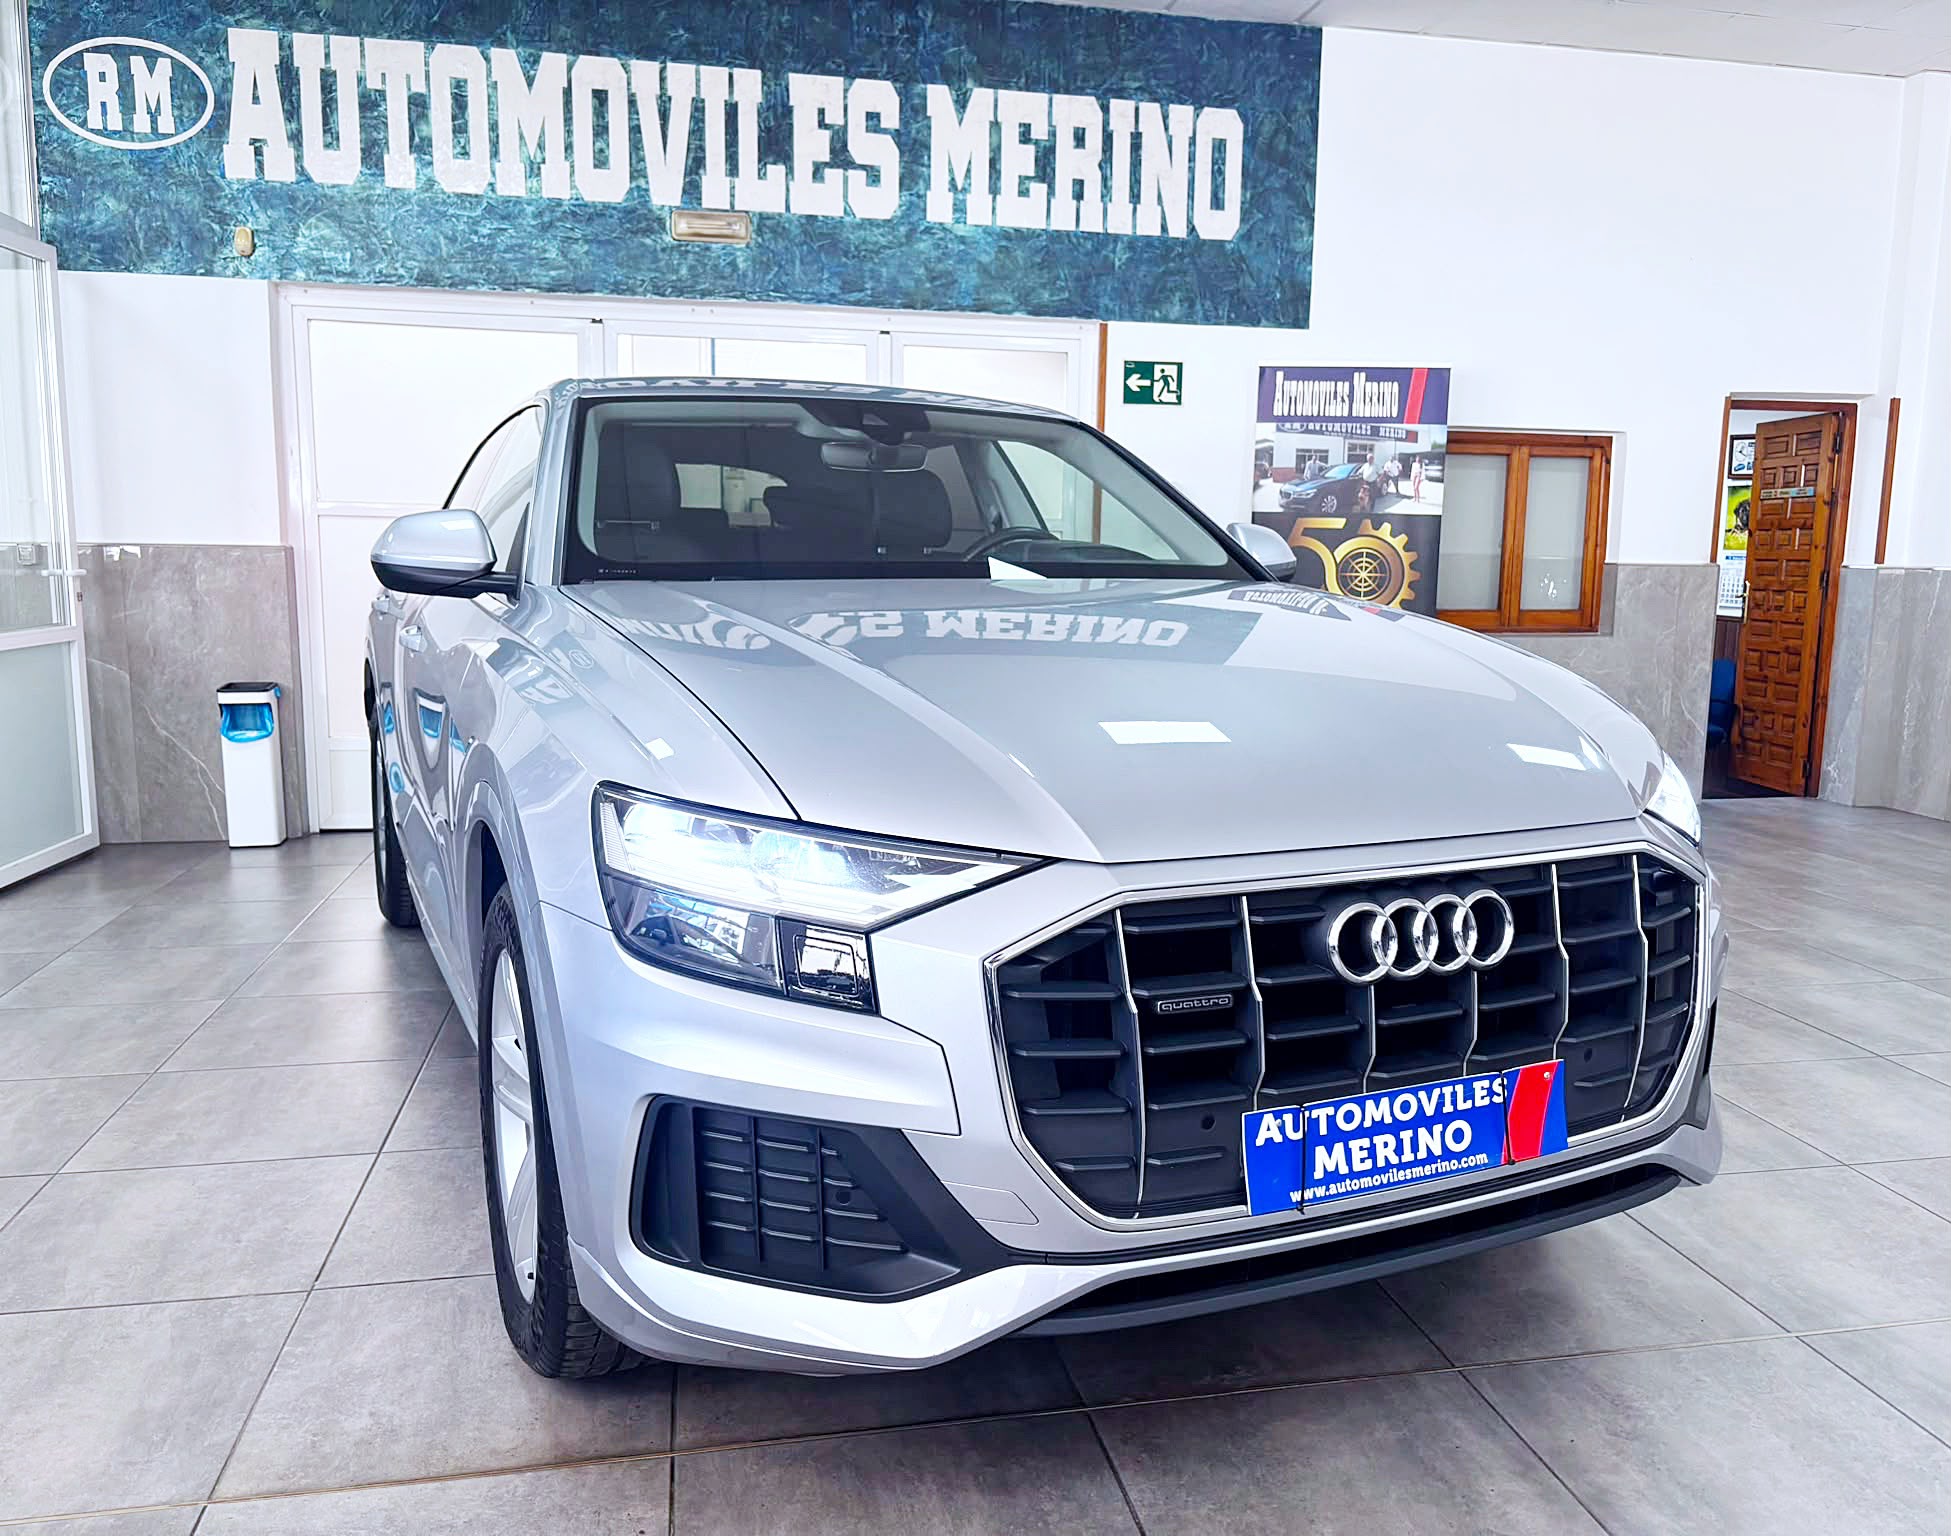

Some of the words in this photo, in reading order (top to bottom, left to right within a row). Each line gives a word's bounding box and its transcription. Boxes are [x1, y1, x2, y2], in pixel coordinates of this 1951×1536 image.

[83, 52, 175, 134] RM
[223, 27, 900, 220] AUTOMOVILES
[925, 84, 1244, 240] MERINO
[1273, 370, 1350, 416] AUTOMOVILES
[1351, 372, 1399, 417] MERINO
[1161, 998, 1229, 1011] quattro
[1255, 1076, 1508, 1147] AUTOMOVILES
[1289, 1151, 1489, 1204] www.automovilesmerino.com
[1313, 1119, 1473, 1180] MERINO
